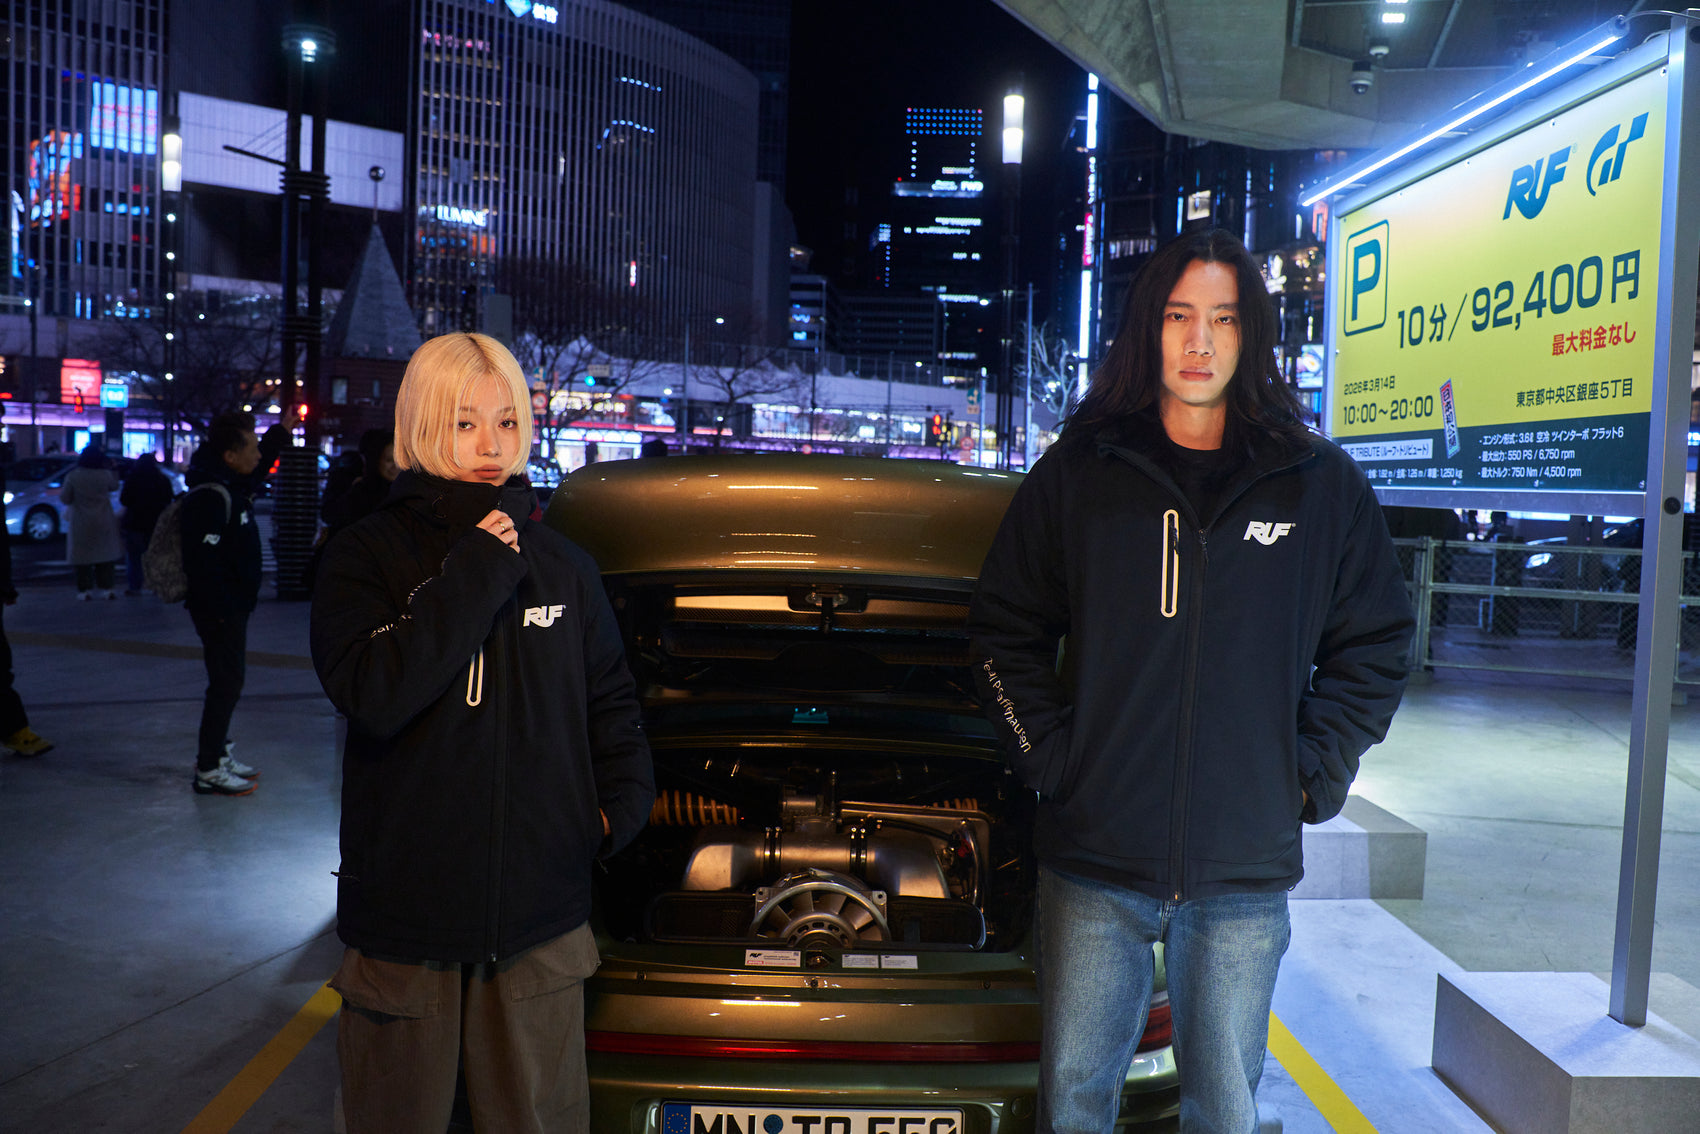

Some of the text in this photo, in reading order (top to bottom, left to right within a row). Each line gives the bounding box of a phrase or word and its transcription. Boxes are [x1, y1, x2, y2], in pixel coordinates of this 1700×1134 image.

[1502, 145, 1572, 220] RUF
[1351, 238, 1381, 322] P
[1552, 321, 1637, 356] 最大料金なし
[1344, 375, 1395, 395] 2026年3月14日
[1516, 377, 1633, 408] 東京都中央区銀座5丁目
[1551, 427, 1590, 442] ツインターボ
[1592, 426, 1624, 440] フラット6
[1522, 449, 1533, 460] PS
[1538, 448, 1560, 461] 6,750
[1560, 450, 1575, 461] rpm
[1526, 466, 1538, 478] Nm
[1543, 465, 1566, 478] 4,500
[1567, 467, 1582, 479] rpm
[1243, 520, 1292, 546] RUF
[523, 604, 564, 628] RUF
